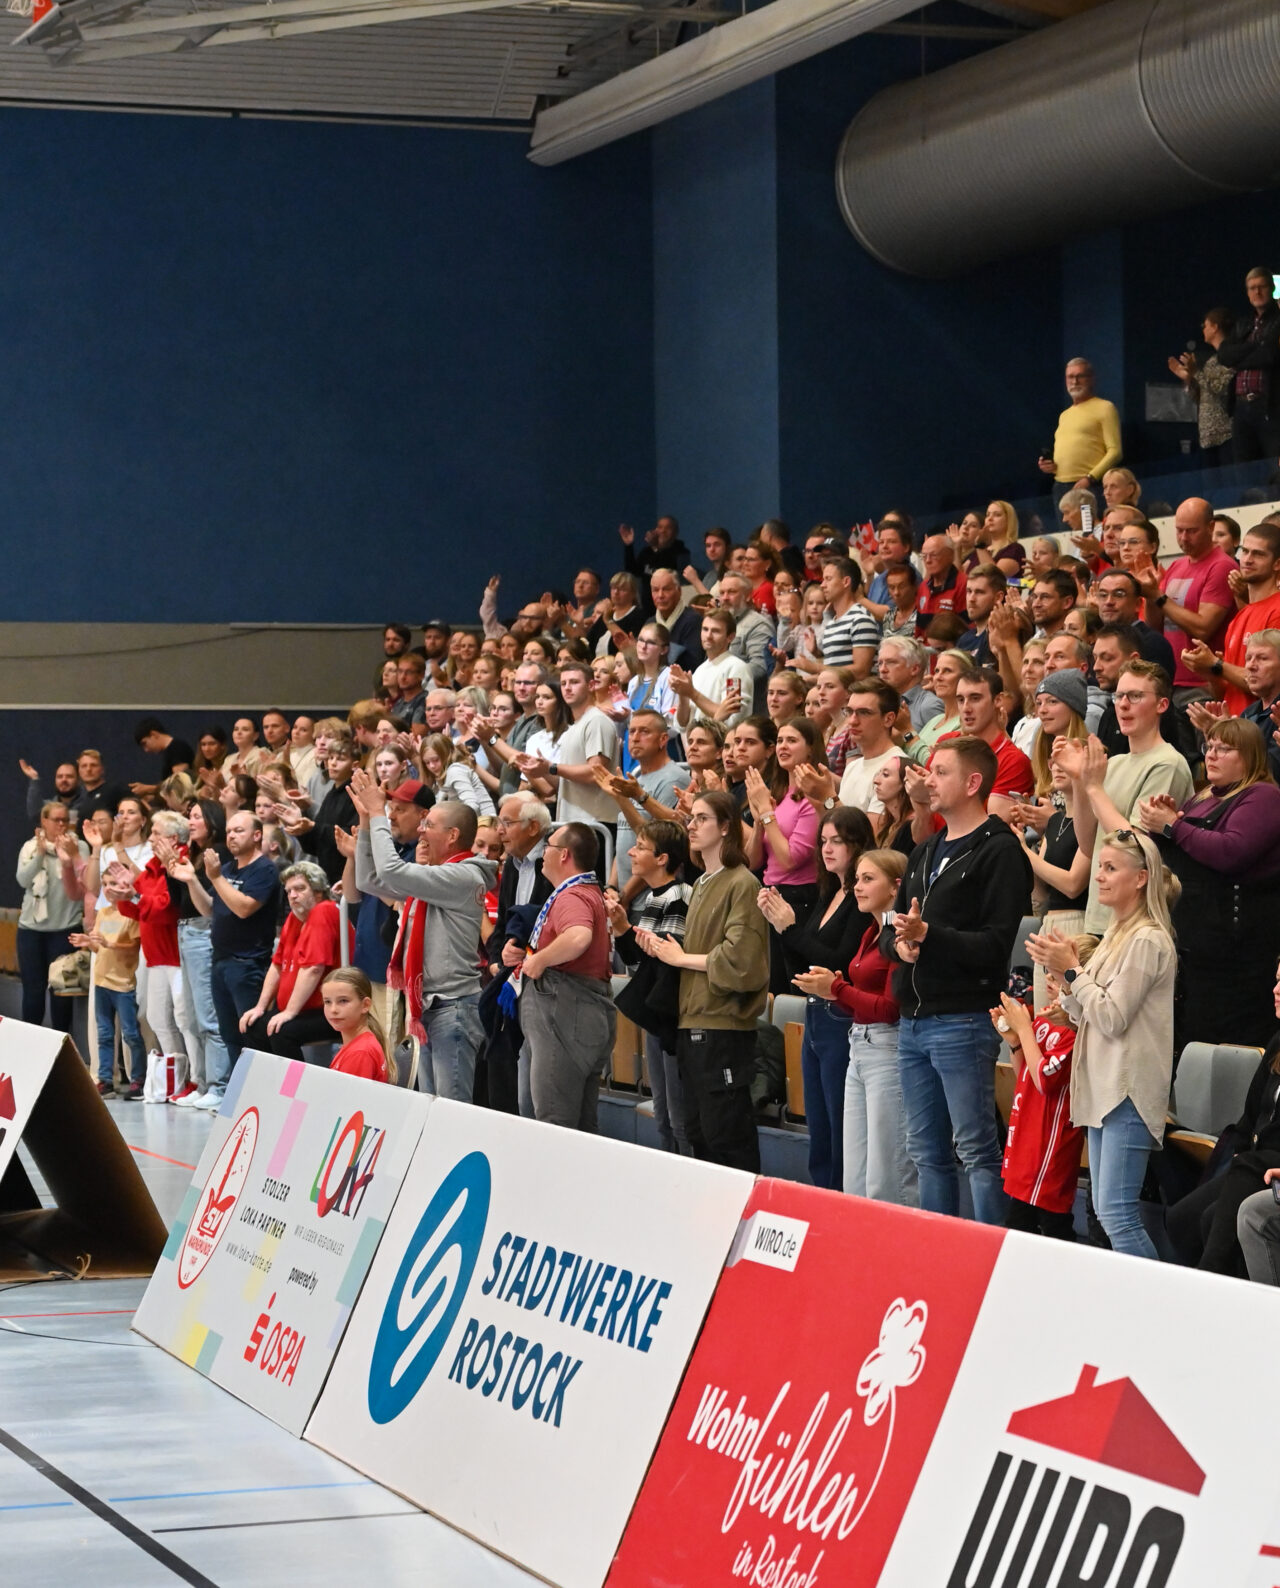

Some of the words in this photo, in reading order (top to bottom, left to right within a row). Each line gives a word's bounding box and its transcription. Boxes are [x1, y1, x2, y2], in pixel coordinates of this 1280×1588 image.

[261, 1177, 291, 1203] STOLZER
[309, 1110, 386, 1221] LOKA
[239, 1205, 259, 1227] LOKA
[256, 1212, 287, 1240] PARTNER
[754, 1225, 797, 1259] WIRO.de
[286, 1266, 313, 1291] powered
[308, 1270, 319, 1296] by
[481, 1231, 673, 1353] STADTWERKE
[260, 1321, 306, 1387] OSPA
[448, 1317, 584, 1428] ROSTOCK
[687, 1383, 760, 1463] Wohn
[721, 1381, 864, 1542] fühlen
[732, 1540, 754, 1578] in
